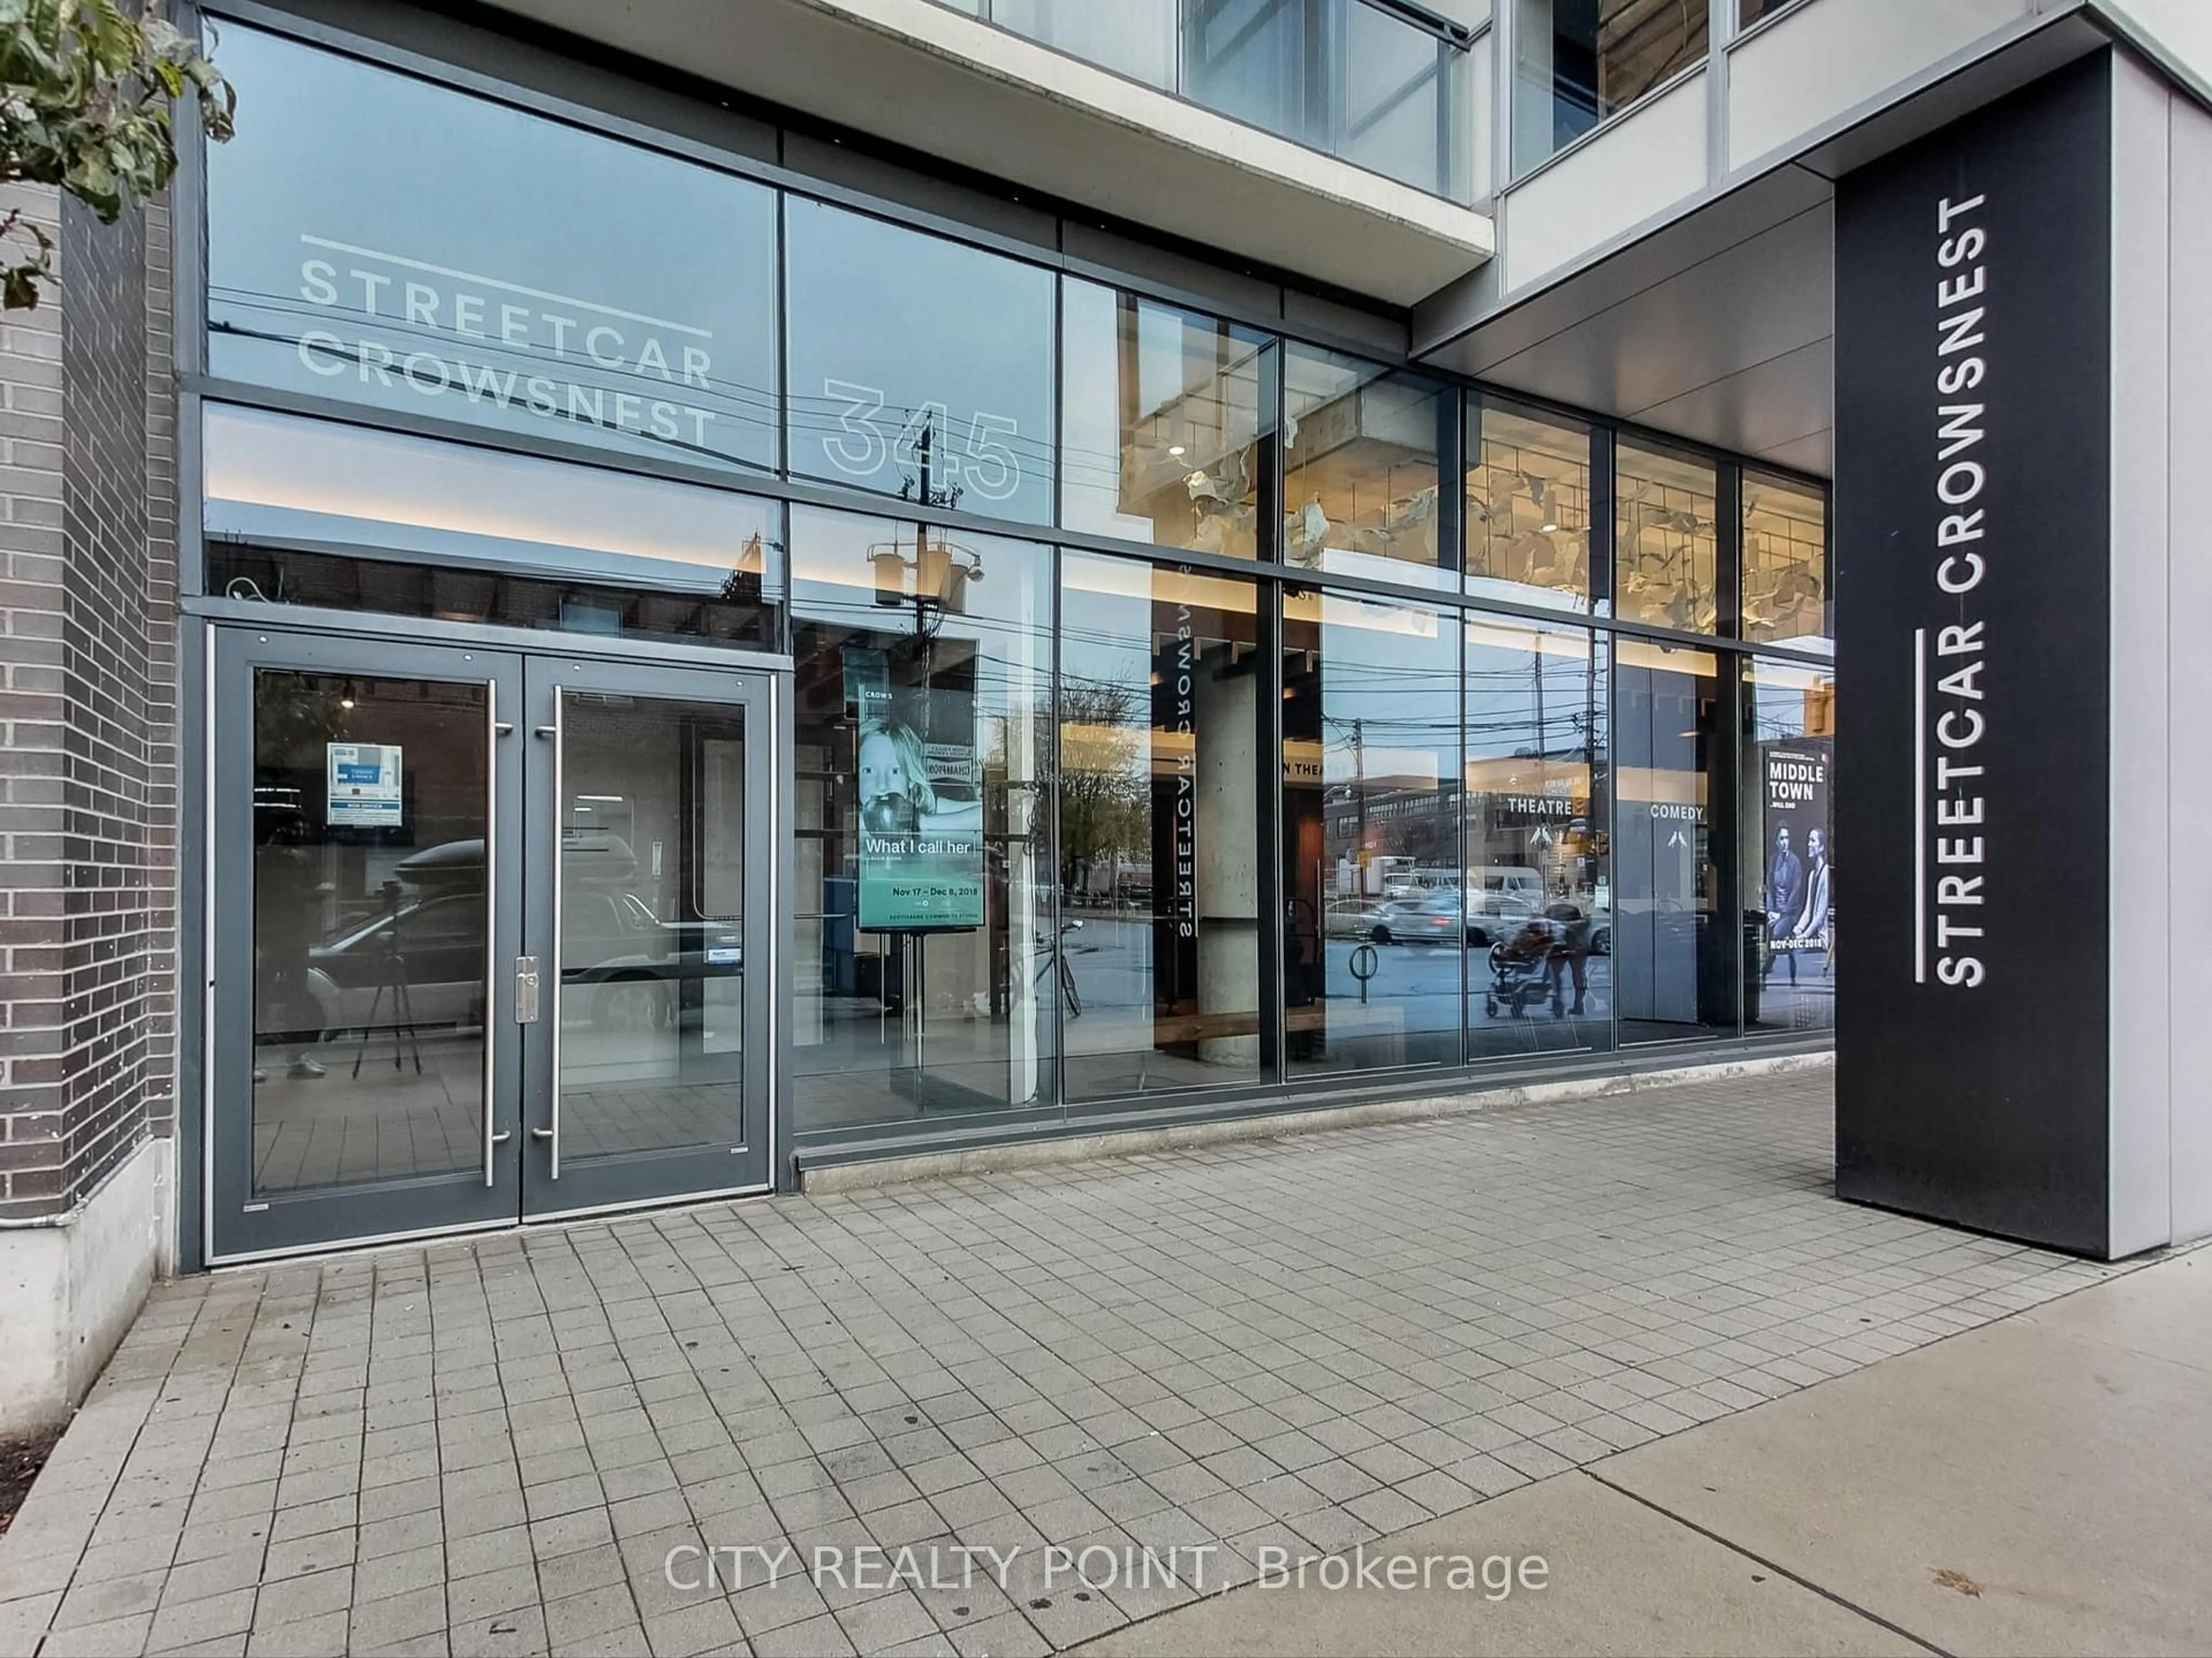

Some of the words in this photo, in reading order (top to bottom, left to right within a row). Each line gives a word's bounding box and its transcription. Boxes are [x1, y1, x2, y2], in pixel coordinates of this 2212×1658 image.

[300, 260, 711, 389] STREETCAR
[298, 331, 715, 446] CROWSNEST
[1936, 194, 1986, 594] CROWSNEST
[822, 378, 1020, 500] 345
[1770, 762, 1824, 782] MIDDLE
[1770, 781, 1813, 800] TOWN
[1508, 797, 1572, 815] THEATRE
[1650, 805, 1704, 820] COMEDY
[1936, 620, 1985, 988] STREETCAR
[866, 839, 906, 854] What
[910, 839, 914, 853] I
[918, 839, 943, 854] call
[947, 839, 970, 854] her
[893, 888, 910, 896] Nov
[912, 888, 922, 896] 17
[930, 887, 947, 896] Dec
[959, 888, 978, 896] 2018
